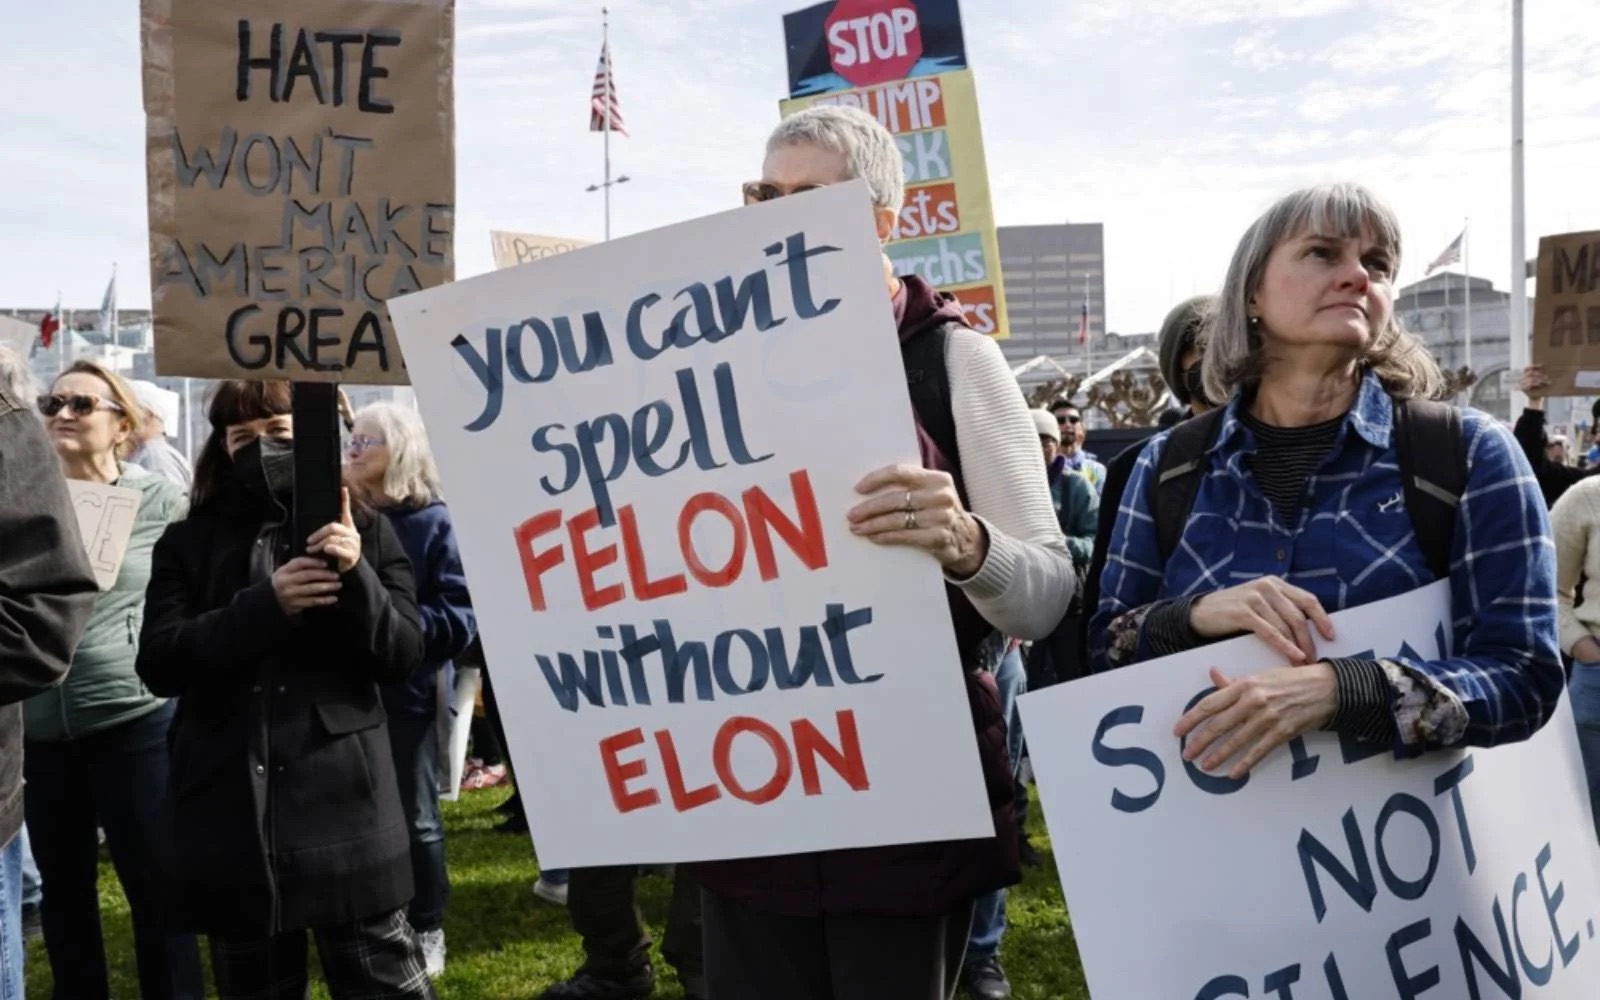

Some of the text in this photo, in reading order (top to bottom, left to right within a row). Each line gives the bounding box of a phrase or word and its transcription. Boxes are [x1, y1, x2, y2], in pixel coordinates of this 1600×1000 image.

[237, 20, 401, 113] HATE
[828, 8, 917, 67] STOP
[157, 238, 423, 302] AMERICA
[281, 198, 456, 264] MAKE
[226, 304, 406, 372] GREA
[451, 231, 844, 432] you can't
[532, 362, 775, 529] spell
[513, 469, 828, 612] FELON
[534, 603, 886, 713] without
[599, 709, 870, 813] ELON
[1297, 756, 1477, 924] NOT
